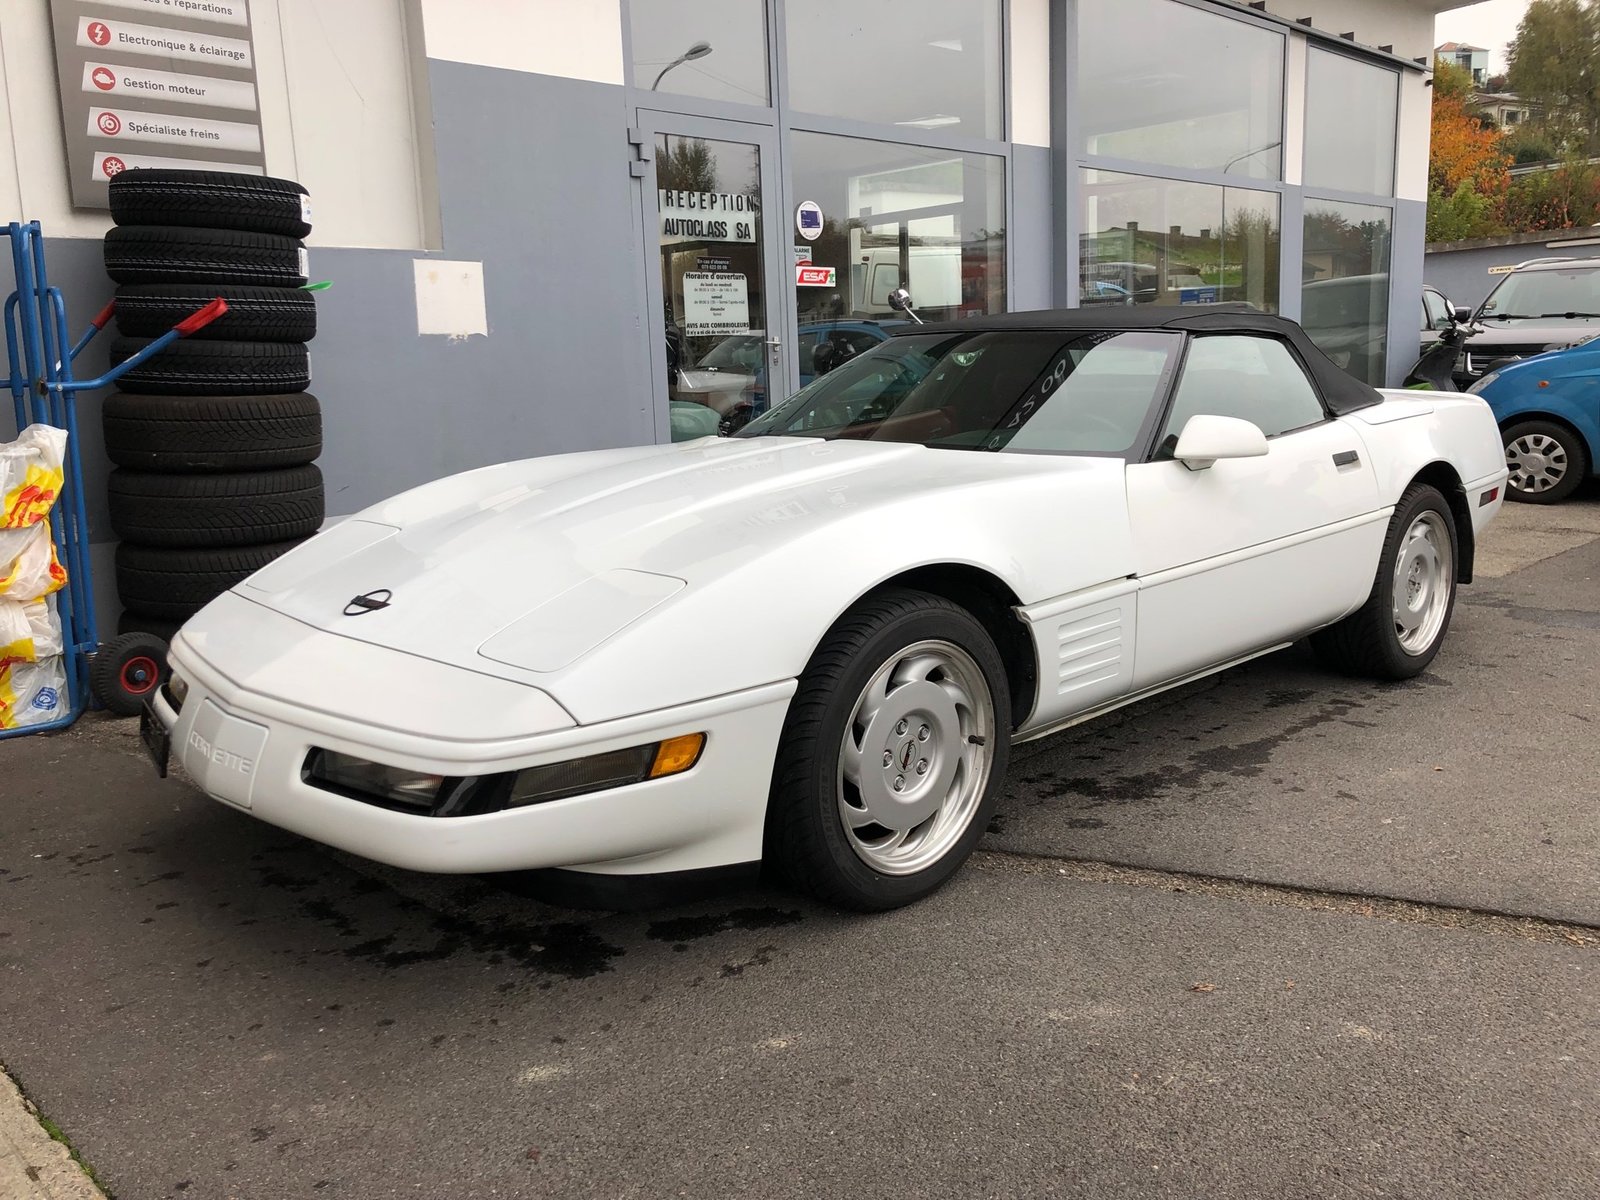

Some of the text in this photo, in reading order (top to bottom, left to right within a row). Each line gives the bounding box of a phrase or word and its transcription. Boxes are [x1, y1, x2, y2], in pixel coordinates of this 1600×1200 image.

[119, 33, 245, 60] Electronique & éclairage
[123, 78, 206, 96] Gestion moteur
[128, 121, 220, 140] Spécialiste freins
[665, 190, 755, 212] RECEPTION
[664, 218, 751, 239] AUTOCLASS SA
